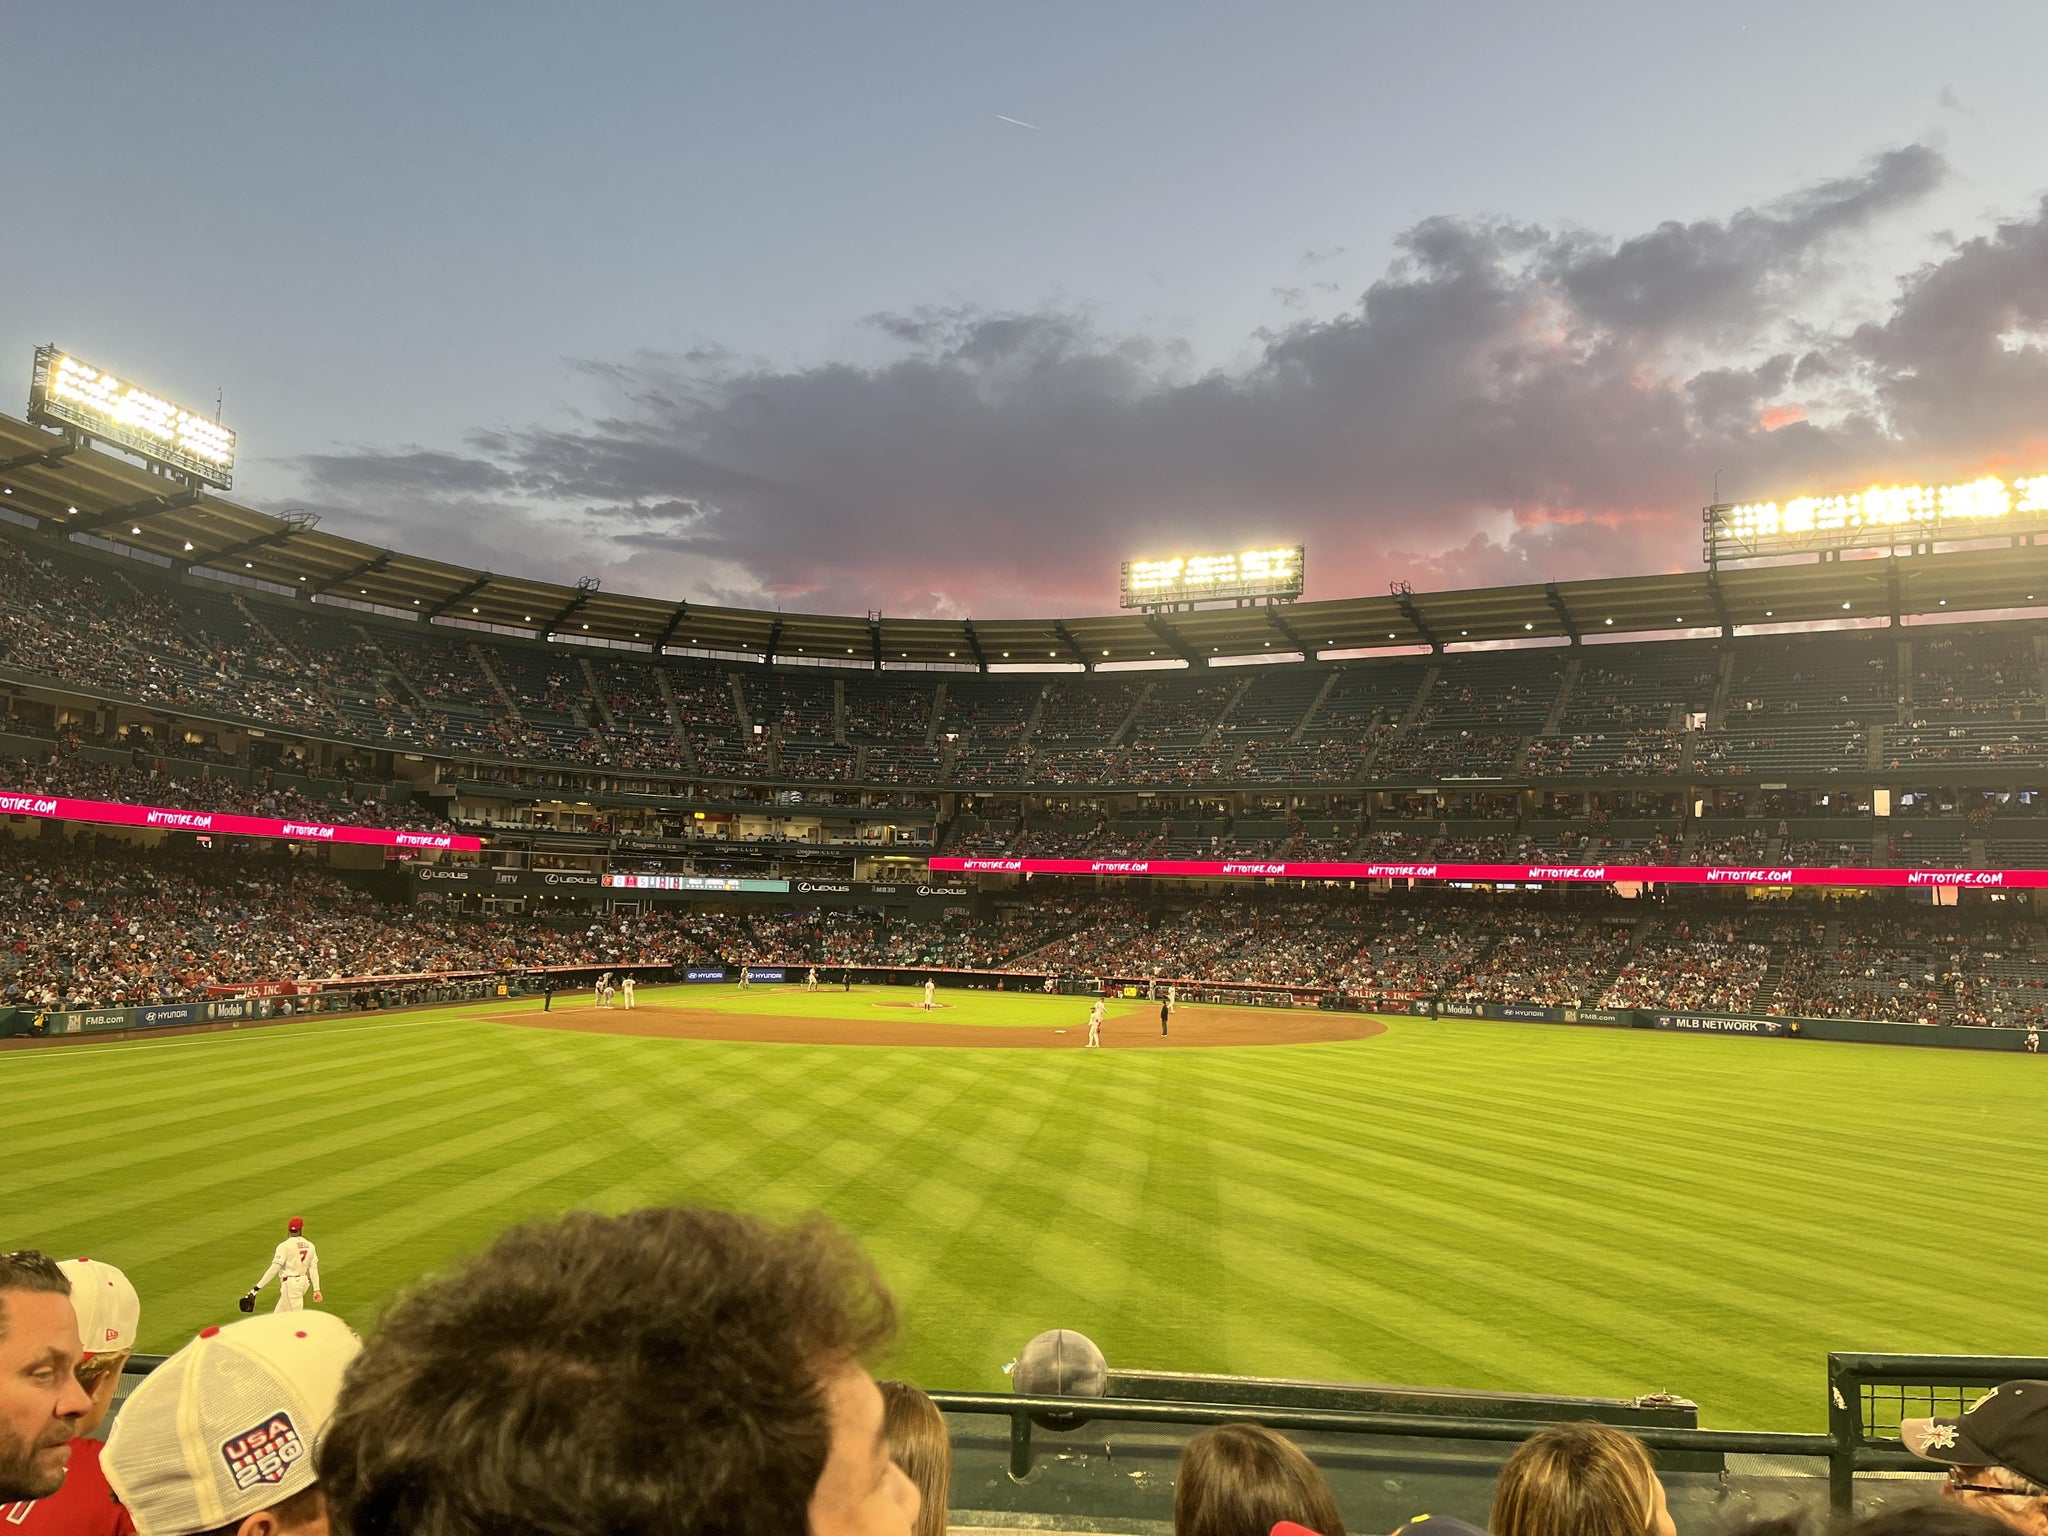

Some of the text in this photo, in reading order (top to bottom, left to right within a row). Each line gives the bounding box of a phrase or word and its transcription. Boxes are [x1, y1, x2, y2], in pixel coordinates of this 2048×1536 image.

[147, 809, 213, 829] NITTOTIRE.COM
[282, 824, 334, 840] NITTOTIRE.COM
[396, 834, 451, 848] NITTOTIRE.COM
[964, 860, 1021, 871] NITTOTIRE.COM
[1092, 861, 1148, 872] NITTOTIRE.COM
[1223, 863, 1285, 875] NITTOTIRE.COM
[1368, 865, 1437, 877] NITTOTIRE.COM
[432, 871, 469, 879] LEXUS
[1528, 866, 1604, 879] NITTOTIRE.COM
[1707, 869, 1793, 882] NITTOTIRE.COM
[1908, 871, 2004, 885] NITTOTIRE.COM
[559, 876, 598, 885] LEXUS
[812, 884, 849, 892] LEXUS
[263, 984, 282, 996] INC.
[157, 1009, 188, 1020] HYUNDAI
[217, 1003, 243, 1017] Modelo
[1446, 1003, 1473, 1015] Modelo
[85, 1016, 124, 1026] FMB.com
[1580, 1013, 1616, 1021] FMB.com
[1676, 1018, 1699, 1028] MLB
[1702, 1020, 1758, 1031] NETWORK
[299, 1250, 308, 1262] 7
[225, 1418, 291, 1460] USA
[236, 1439, 303, 1488] 250
